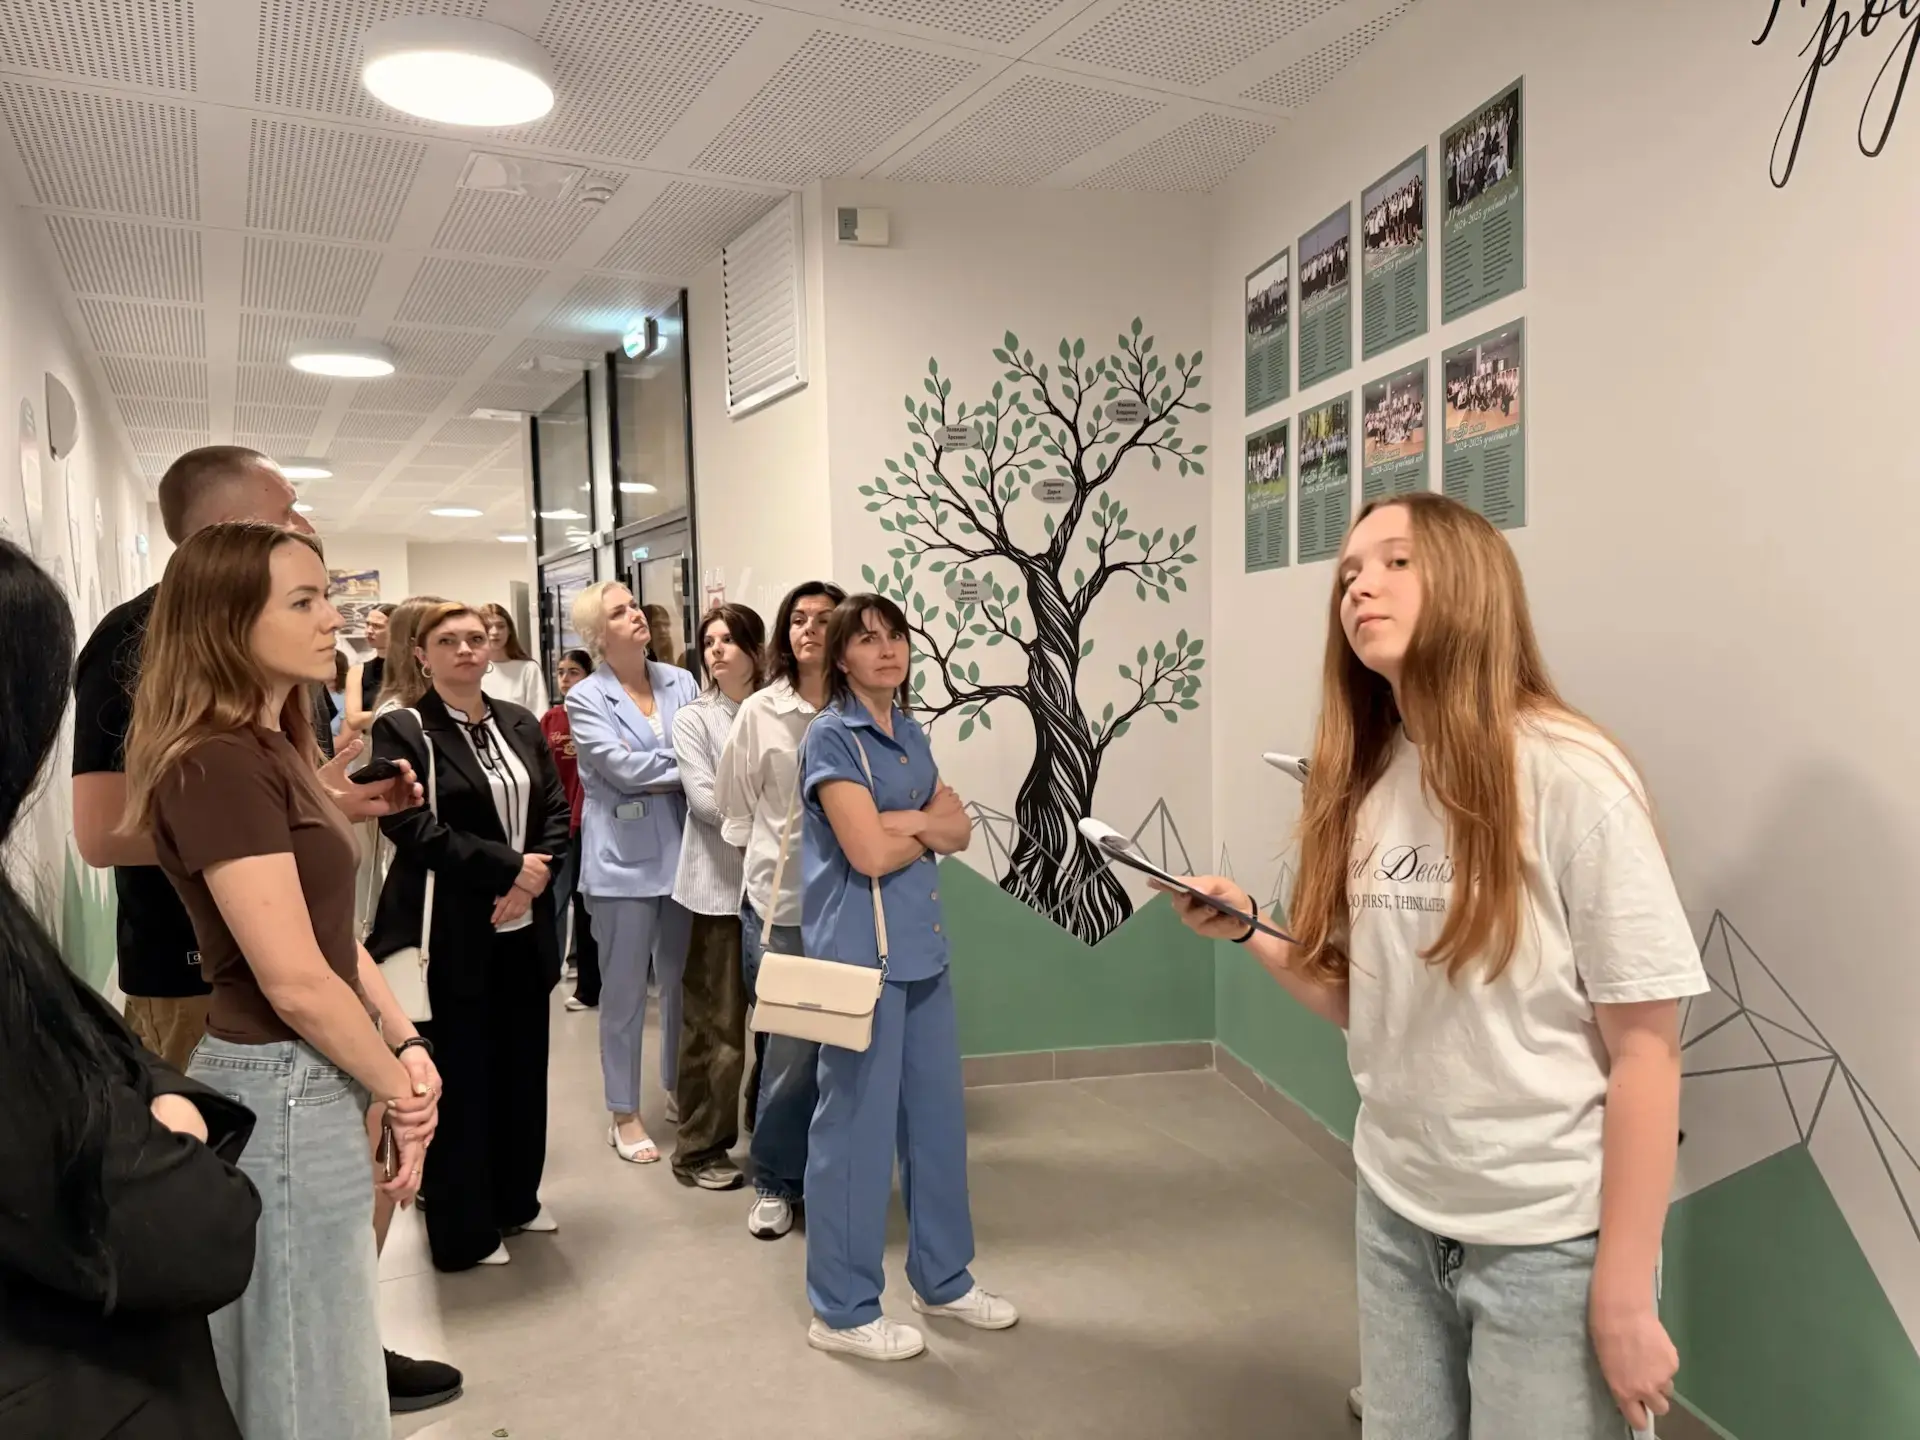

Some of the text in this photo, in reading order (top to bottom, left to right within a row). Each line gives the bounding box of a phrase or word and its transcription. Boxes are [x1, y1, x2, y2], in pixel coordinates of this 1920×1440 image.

[1453, 436, 1483, 453] 2024-2025
[1483, 429, 1508, 448] учебный
[1374, 845, 1456, 884] Decis
[1362, 894, 1392, 911] FIRST,
[1395, 896, 1425, 911] THINK
